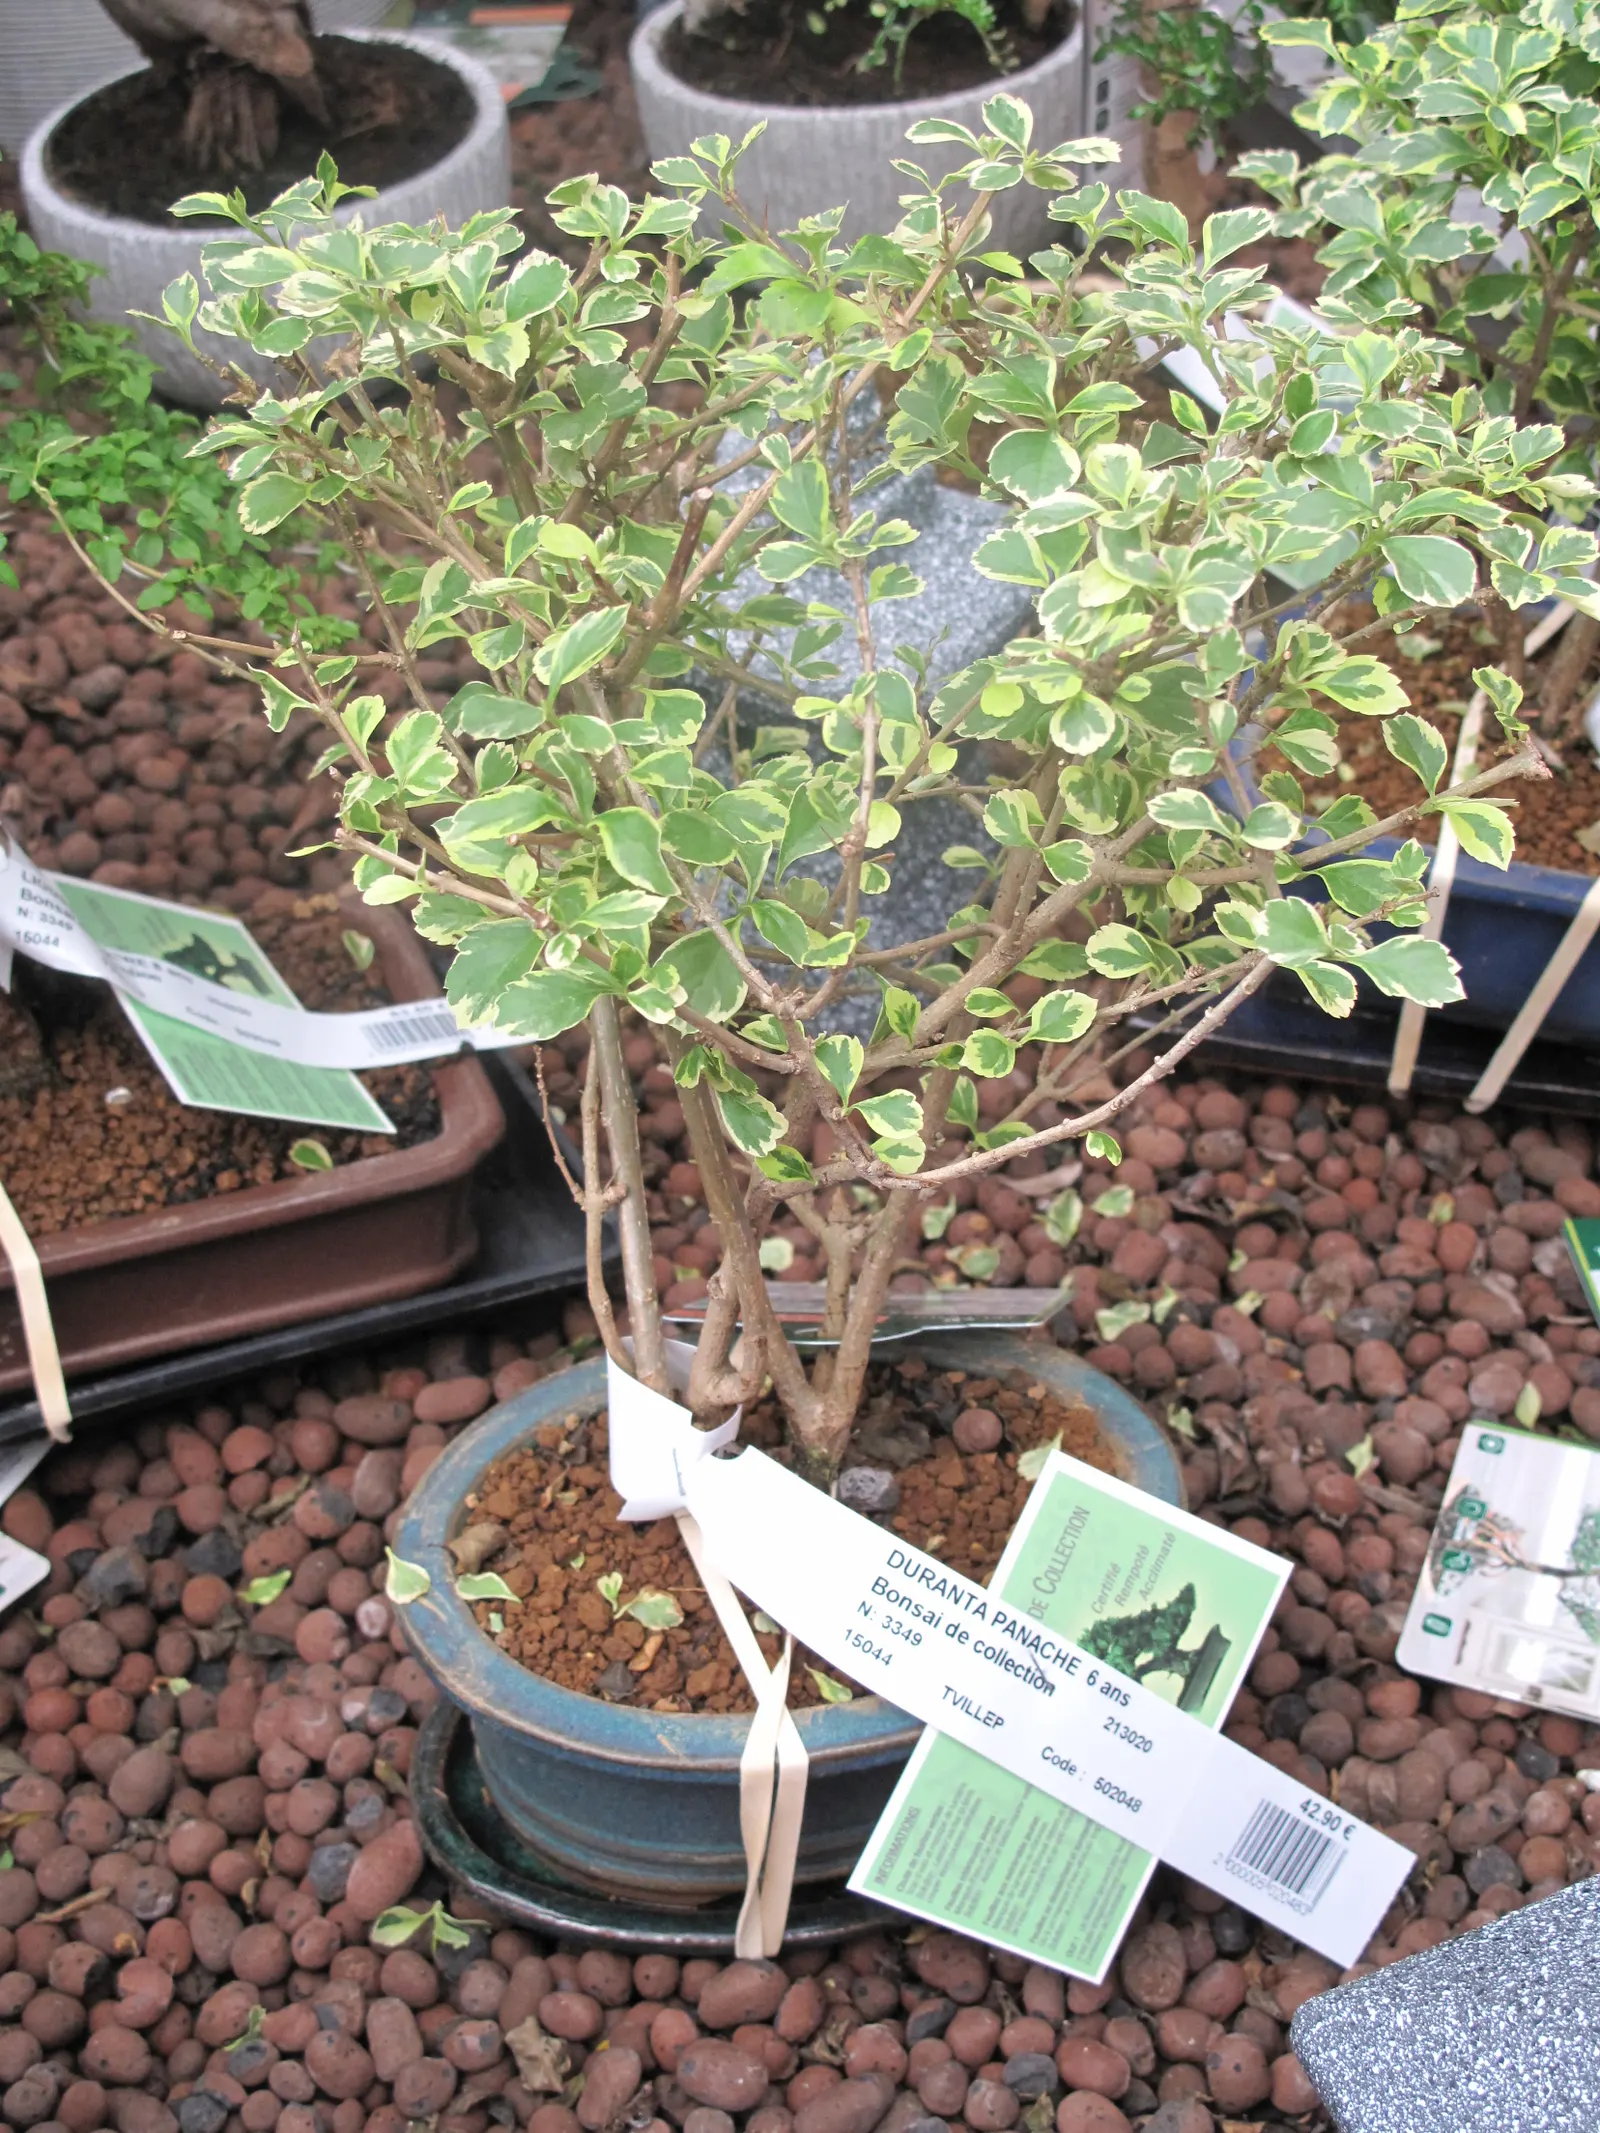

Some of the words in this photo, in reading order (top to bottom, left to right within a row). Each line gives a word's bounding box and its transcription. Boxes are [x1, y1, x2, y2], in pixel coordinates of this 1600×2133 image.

[15, 930, 60, 948] 15044
[1114, 1544, 1150, 1607] Rempoté
[1138, 1531, 1176, 1601] Acclimaté
[1091, 1561, 1121, 1614] Certifié
[844, 1629, 893, 1666] 15044
[871, 1576, 942, 1629] Bonsai
[945, 1622, 969, 1645] de
[973, 1640, 1056, 1697] collection
[882, 1615, 923, 1647] 3349
[886, 1549, 988, 1621] DURANTA
[991, 1611, 1081, 1676] PANACHE
[1087, 1670, 1100, 1686] 6
[1100, 1681, 1132, 1707] ans
[941, 1685, 1005, 1730] TVILLEP
[1103, 1716, 1153, 1753] 213020
[1093, 1777, 1143, 1813] 502048
[1300, 1799, 1342, 1831] 42.90
